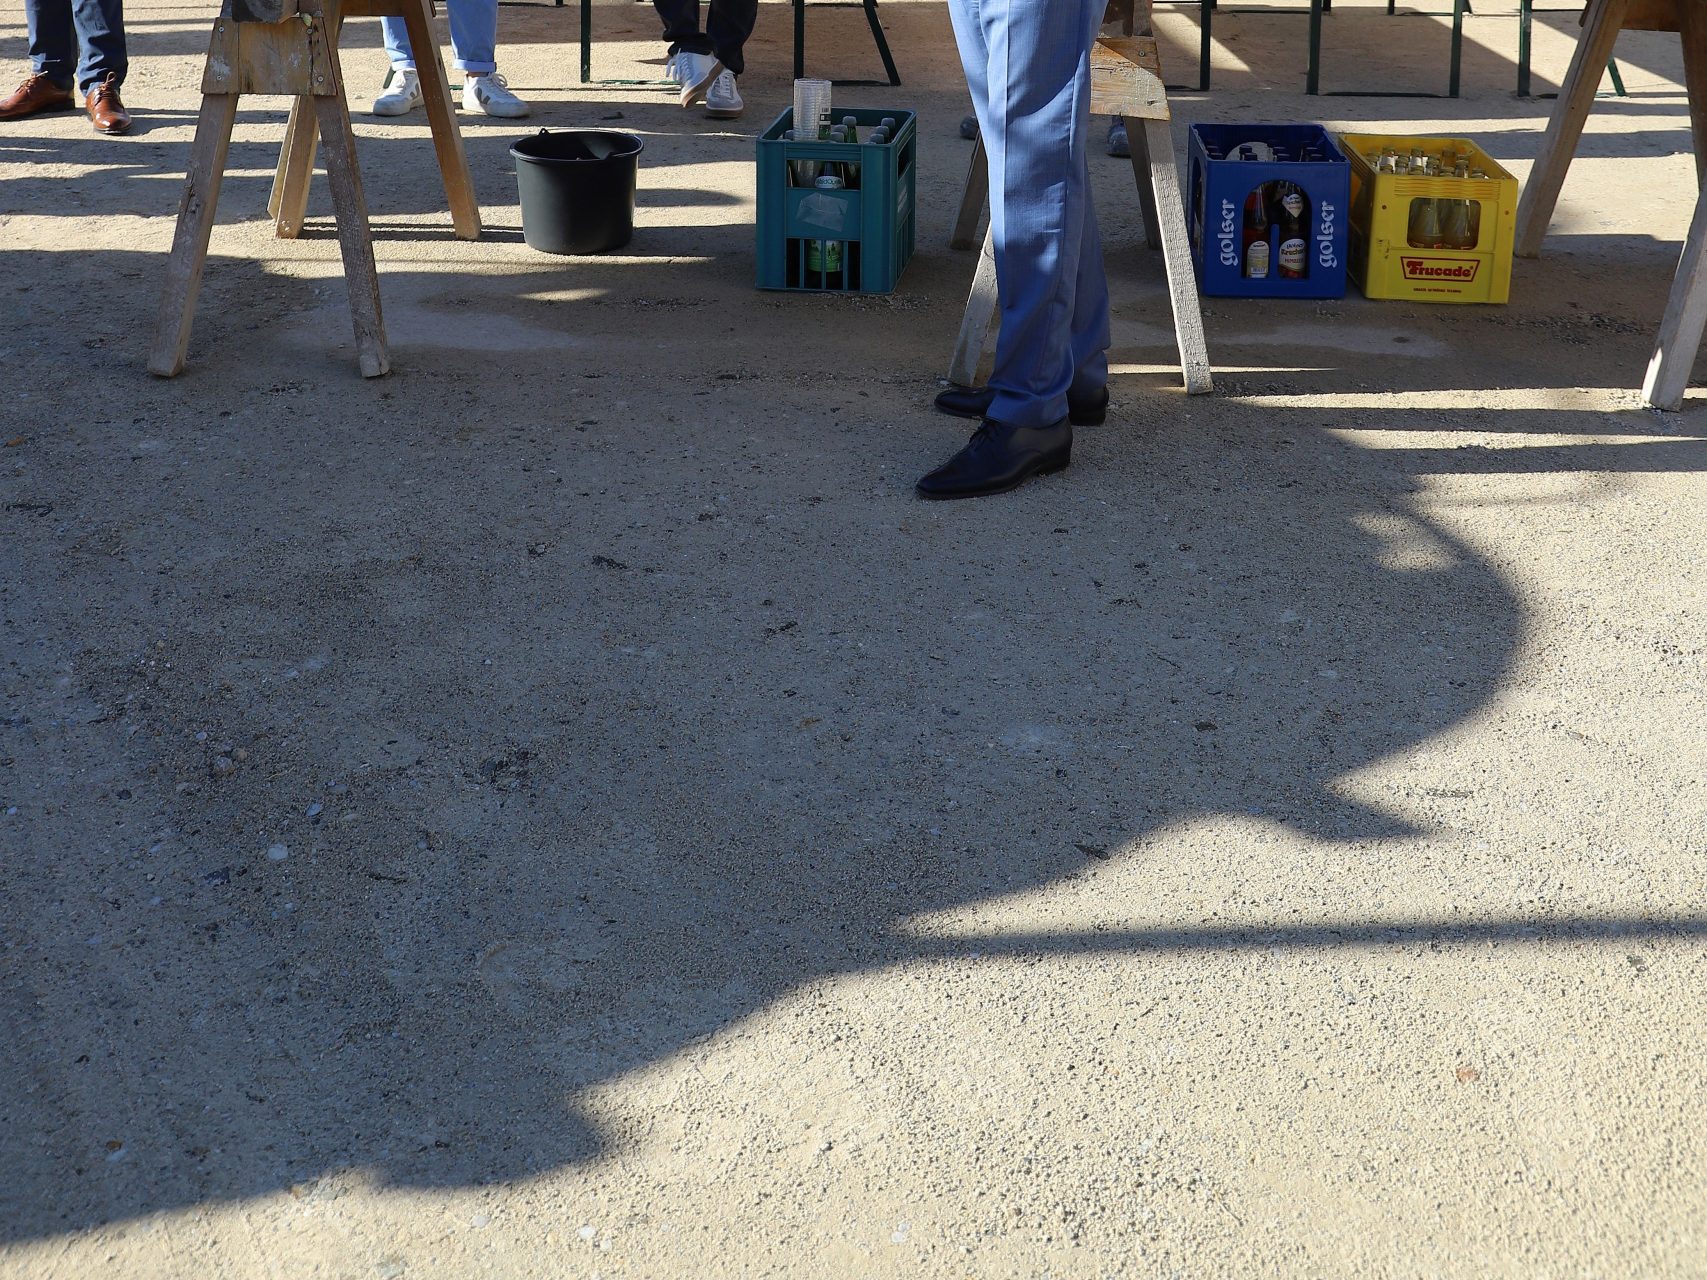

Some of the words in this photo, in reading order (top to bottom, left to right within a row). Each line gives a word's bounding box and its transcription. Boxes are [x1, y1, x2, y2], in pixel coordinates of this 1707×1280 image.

[1217, 198, 1239, 267] golser
[1316, 200, 1338, 268] golser
[1406, 260, 1472, 277] Frucade
